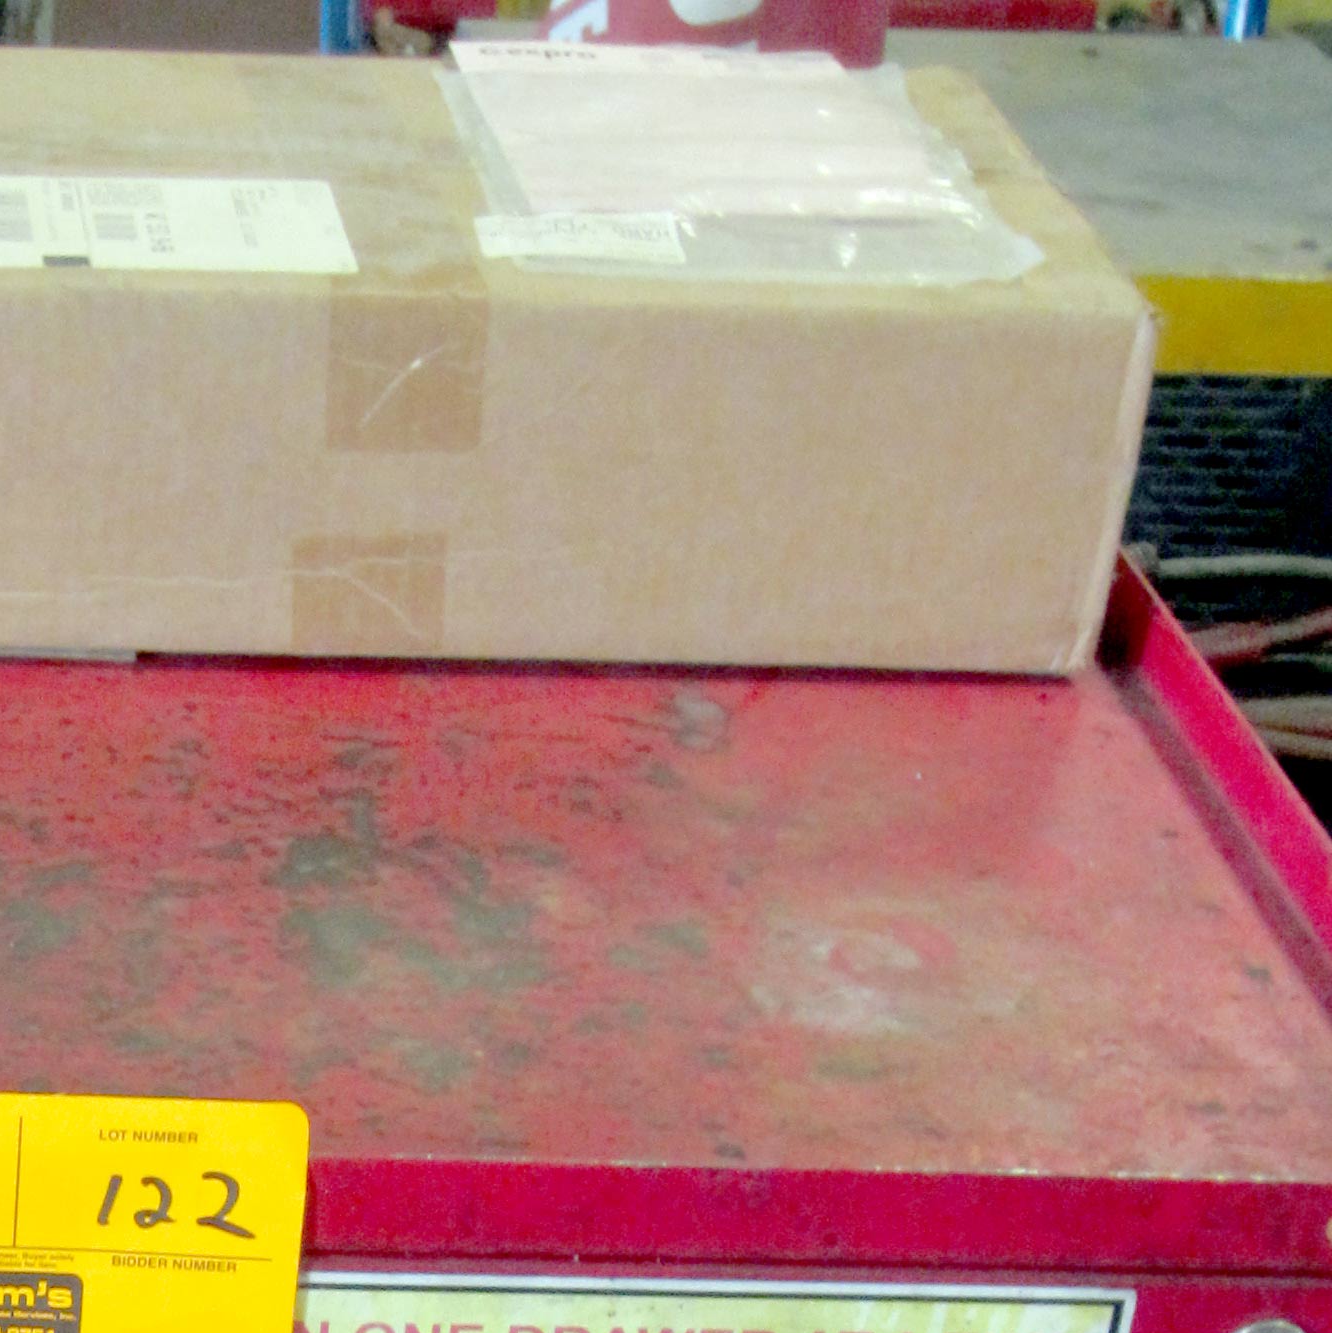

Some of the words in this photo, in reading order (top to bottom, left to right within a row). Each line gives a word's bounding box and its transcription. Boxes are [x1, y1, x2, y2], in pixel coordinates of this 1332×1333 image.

[98, 1129, 129, 1143] LOT
[132, 1130, 199, 1145] NUMBER
[96, 1170, 257, 1240] 122
[111, 1255, 167, 1270] BIDDER
[171, 1258, 238, 1274] NUMBER
